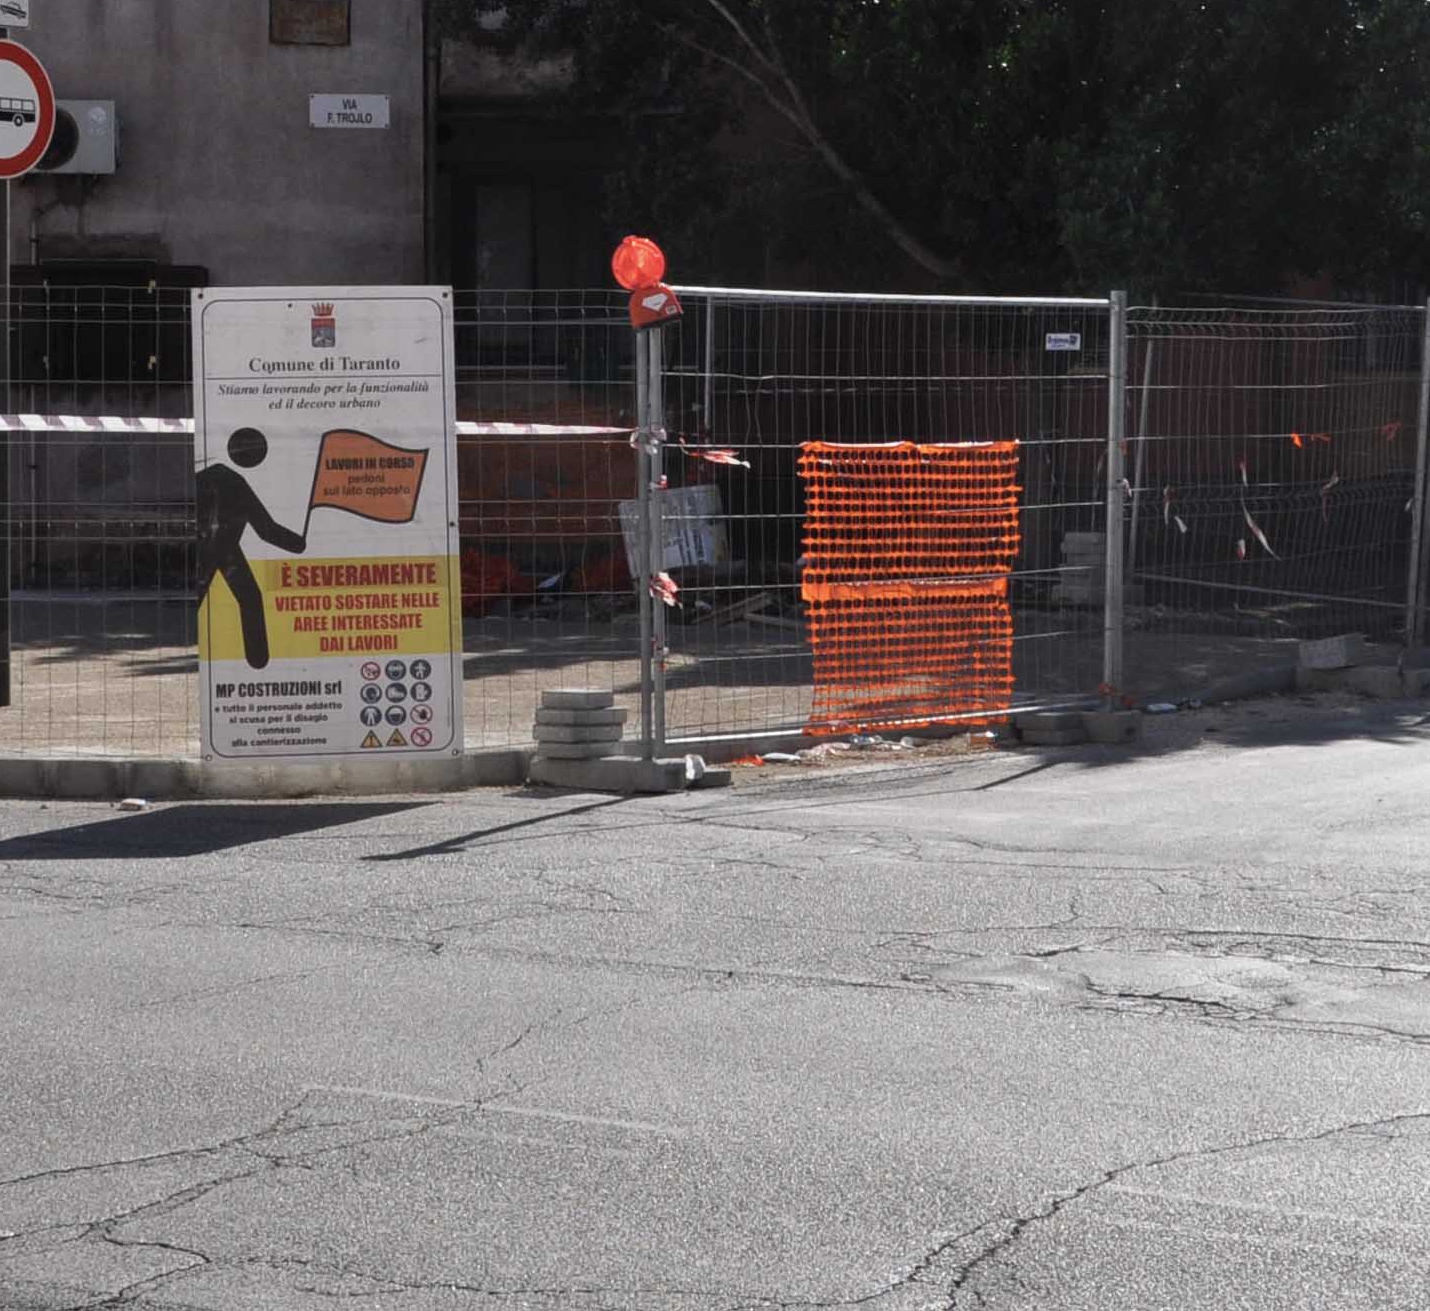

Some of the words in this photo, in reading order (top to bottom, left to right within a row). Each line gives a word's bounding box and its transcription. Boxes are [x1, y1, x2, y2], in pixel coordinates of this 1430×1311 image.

[342, 98, 357, 110] VIA
[337, 112, 373, 124] TROJLO
[249, 358, 315, 372] Comune
[320, 356, 334, 371] di
[339, 356, 400, 371] Taranto
[219, 384, 259, 395] Stiamo
[262, 383, 320, 395] lavorando
[324, 385, 343, 397] per
[346, 382, 357, 394] la
[359, 380, 429, 396] funzionalità
[268, 398, 282, 410] ed
[286, 397, 294, 409] il
[297, 397, 336, 409] decoro
[339, 397, 381, 408] urbano
[326, 456, 363, 470] LAVORI
[365, 456, 377, 469] IN
[379, 455, 415, 469] CORSO
[348, 473, 385, 485] pedoni
[323, 485, 340, 497] sul
[343, 485, 363, 496] lato
[365, 485, 411, 498] opposto
[281, 562, 292, 587] È
[297, 563, 436, 587] SEVERAMENTE
[275, 595, 331, 612] VIETATO
[335, 593, 398, 610] SOSTARE
[401, 592, 439, 609] NELLE
[294, 616, 328, 632] AREE
[332, 613, 422, 631] INTERESSATE
[319, 636, 344, 652] DAI
[348, 634, 398, 650] LAVORI
[216, 683, 235, 698] MP
[238, 681, 321, 698] COSTRUZIONI
[324, 680, 342, 695] srl
[223, 704, 246, 713] tutto
[257, 703, 303, 713] personale
[305, 701, 343, 711] addetto
[229, 716, 237, 724] si
[239, 716, 265, 724] scusa
[268, 715, 284, 724] per
[294, 713, 328, 724] disagio
[257, 727, 301, 735] connesso
